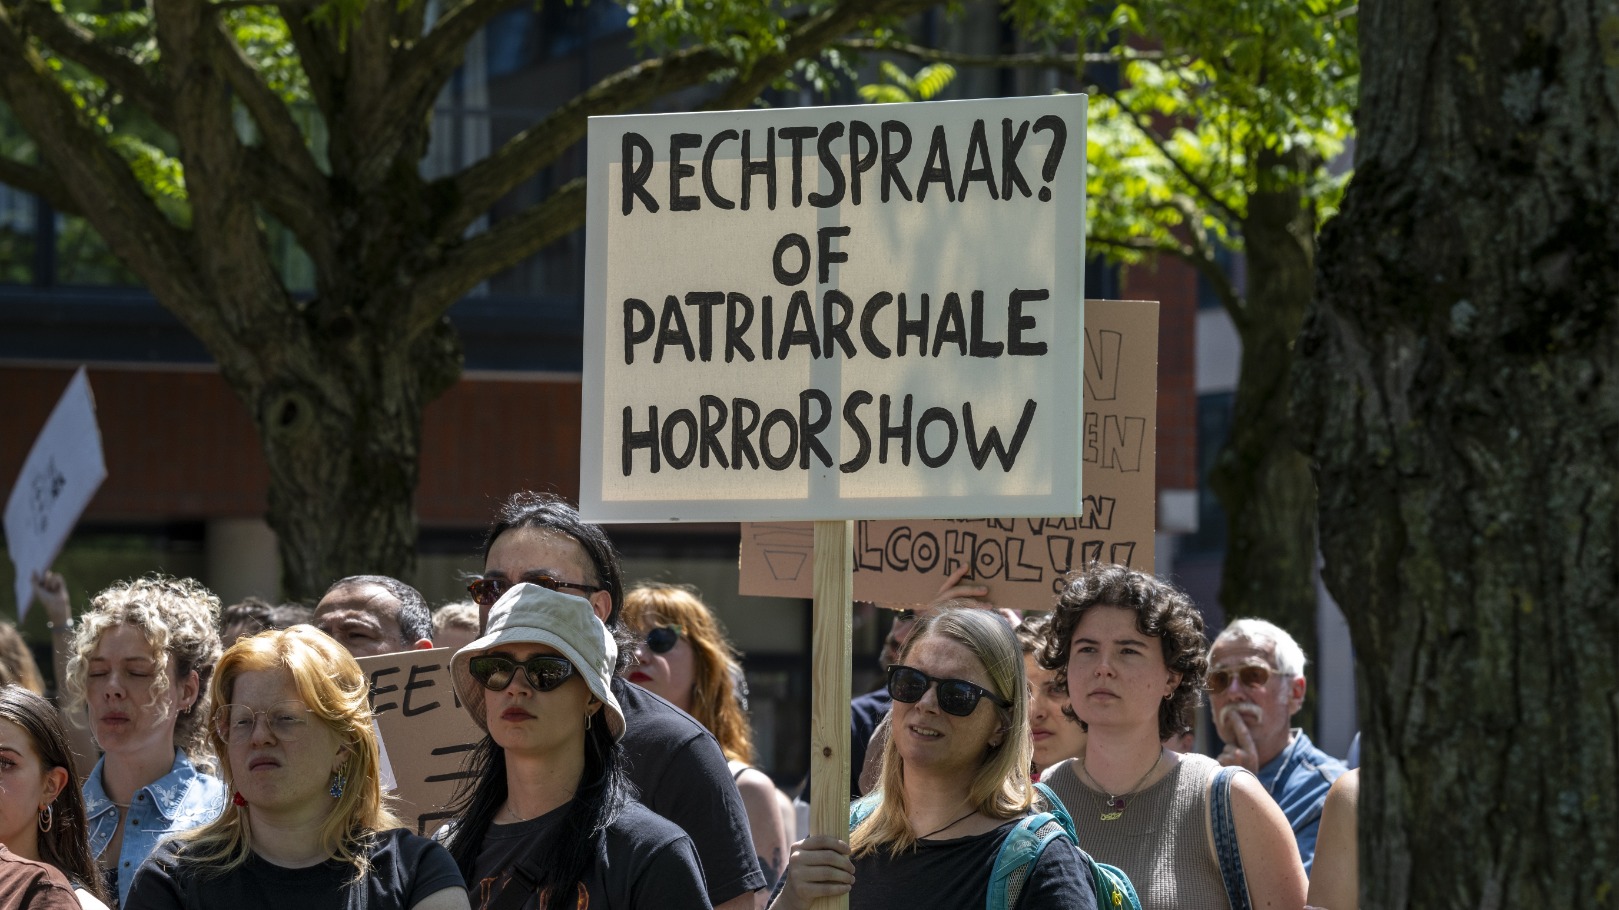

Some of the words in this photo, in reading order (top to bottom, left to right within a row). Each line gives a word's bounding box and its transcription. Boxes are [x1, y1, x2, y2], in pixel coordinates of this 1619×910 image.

[622, 115, 1067, 216] RECHTSPRAAK?
[772, 226, 851, 287] OF
[623, 288, 1050, 366] PATRIARCHALE
[622, 389, 1038, 477] HORRORSHOW
[852, 518, 1137, 595] LCOHOL!!
